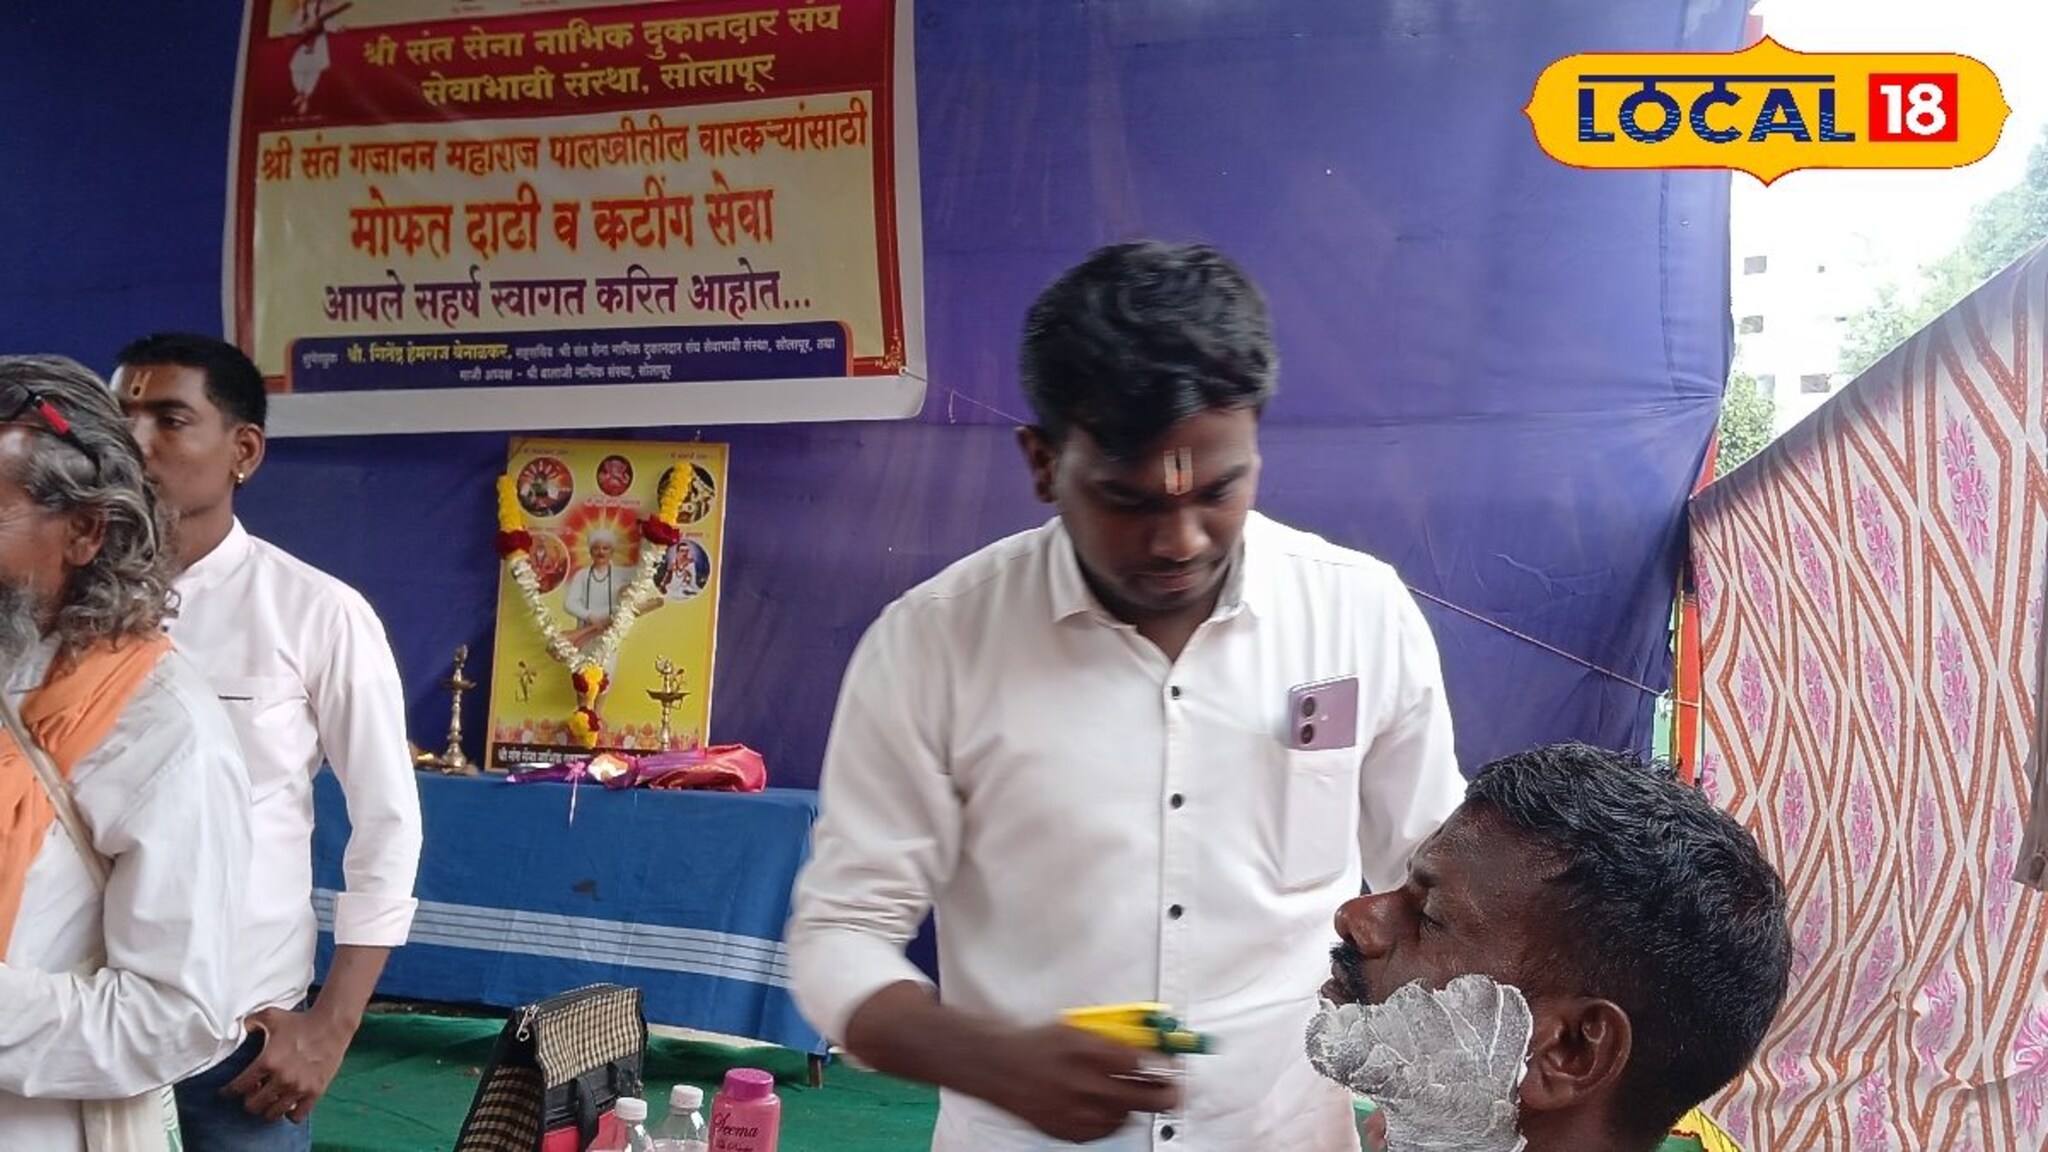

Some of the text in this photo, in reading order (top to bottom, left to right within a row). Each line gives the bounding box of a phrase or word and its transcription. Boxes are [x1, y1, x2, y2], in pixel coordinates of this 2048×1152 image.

[364, 1, 841, 65] श्री संत सेना नाभिक दुकानदार संघ
[423, 54, 776, 105] सेवाभावी संस्था, सोलापूर
[262, 137, 292, 180] श्री
[302, 133, 339, 180] संत
[350, 141, 437, 175] गजानन
[446, 138, 540, 177] महाराज
[550, 114, 689, 169] पालखीतील
[350, 185, 453, 258] मोफत
[553, 201, 580, 251] व
[592, 176, 694, 250] कटींग
[704, 169, 775, 246] सेवा
[325, 257, 811, 328] आपले सहर्ष स्वागत करित आहोत...
